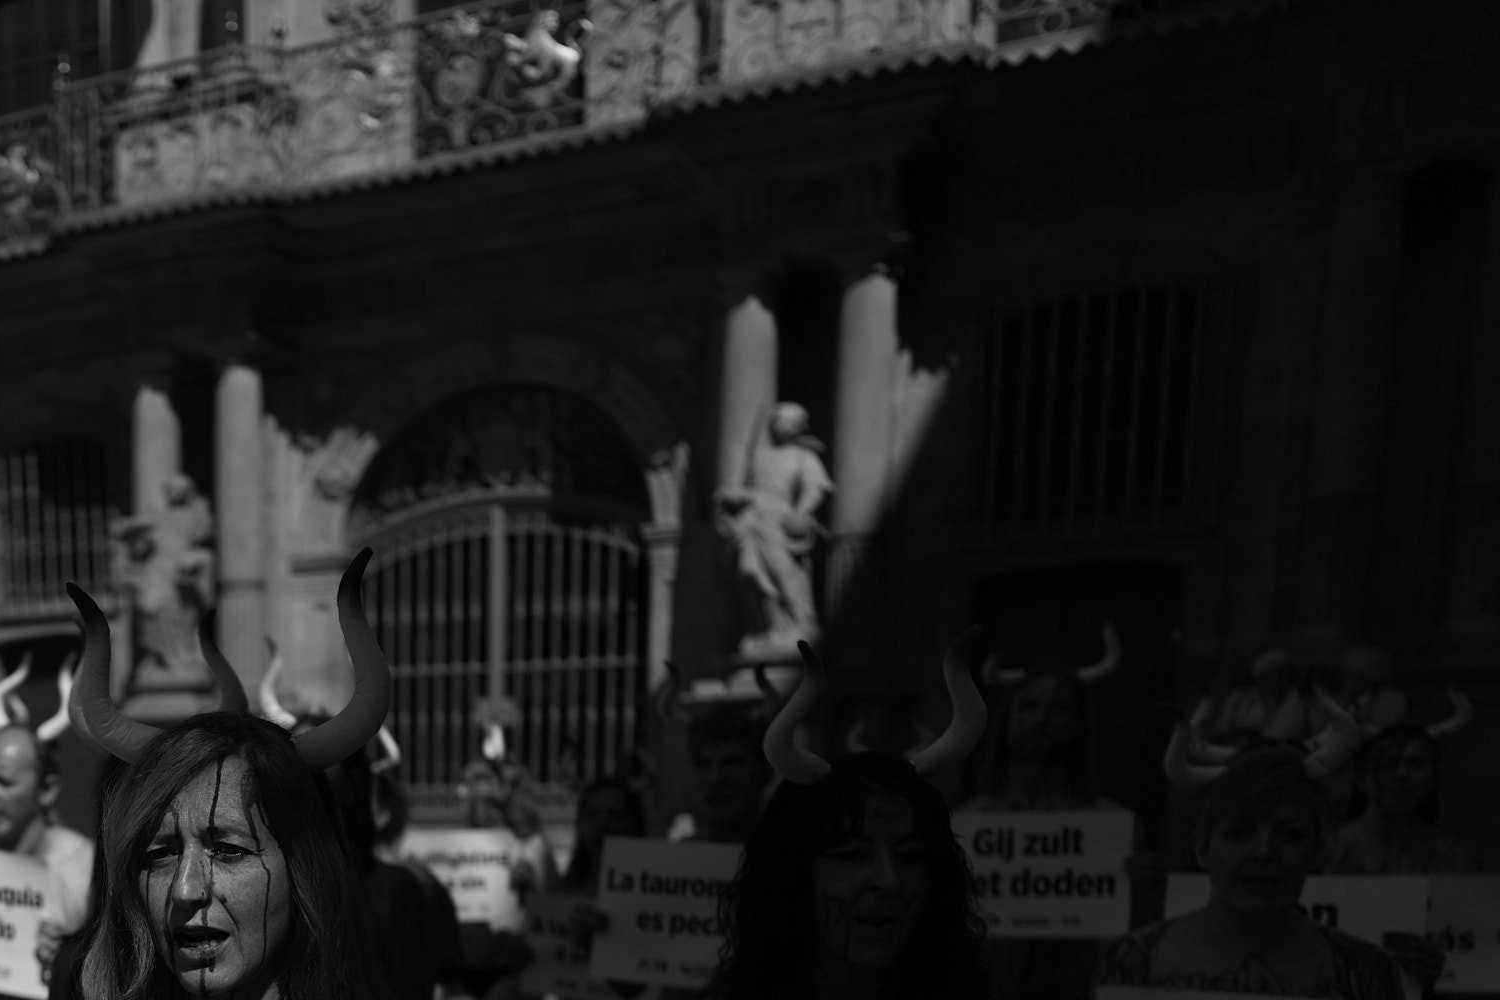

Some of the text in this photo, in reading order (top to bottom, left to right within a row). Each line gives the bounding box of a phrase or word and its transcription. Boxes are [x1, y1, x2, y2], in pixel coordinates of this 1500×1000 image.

[971, 824, 1085, 863] Gij zult
[606, 867, 634, 893] La
[1009, 867, 1117, 898] doden
[635, 910, 663, 933] es
